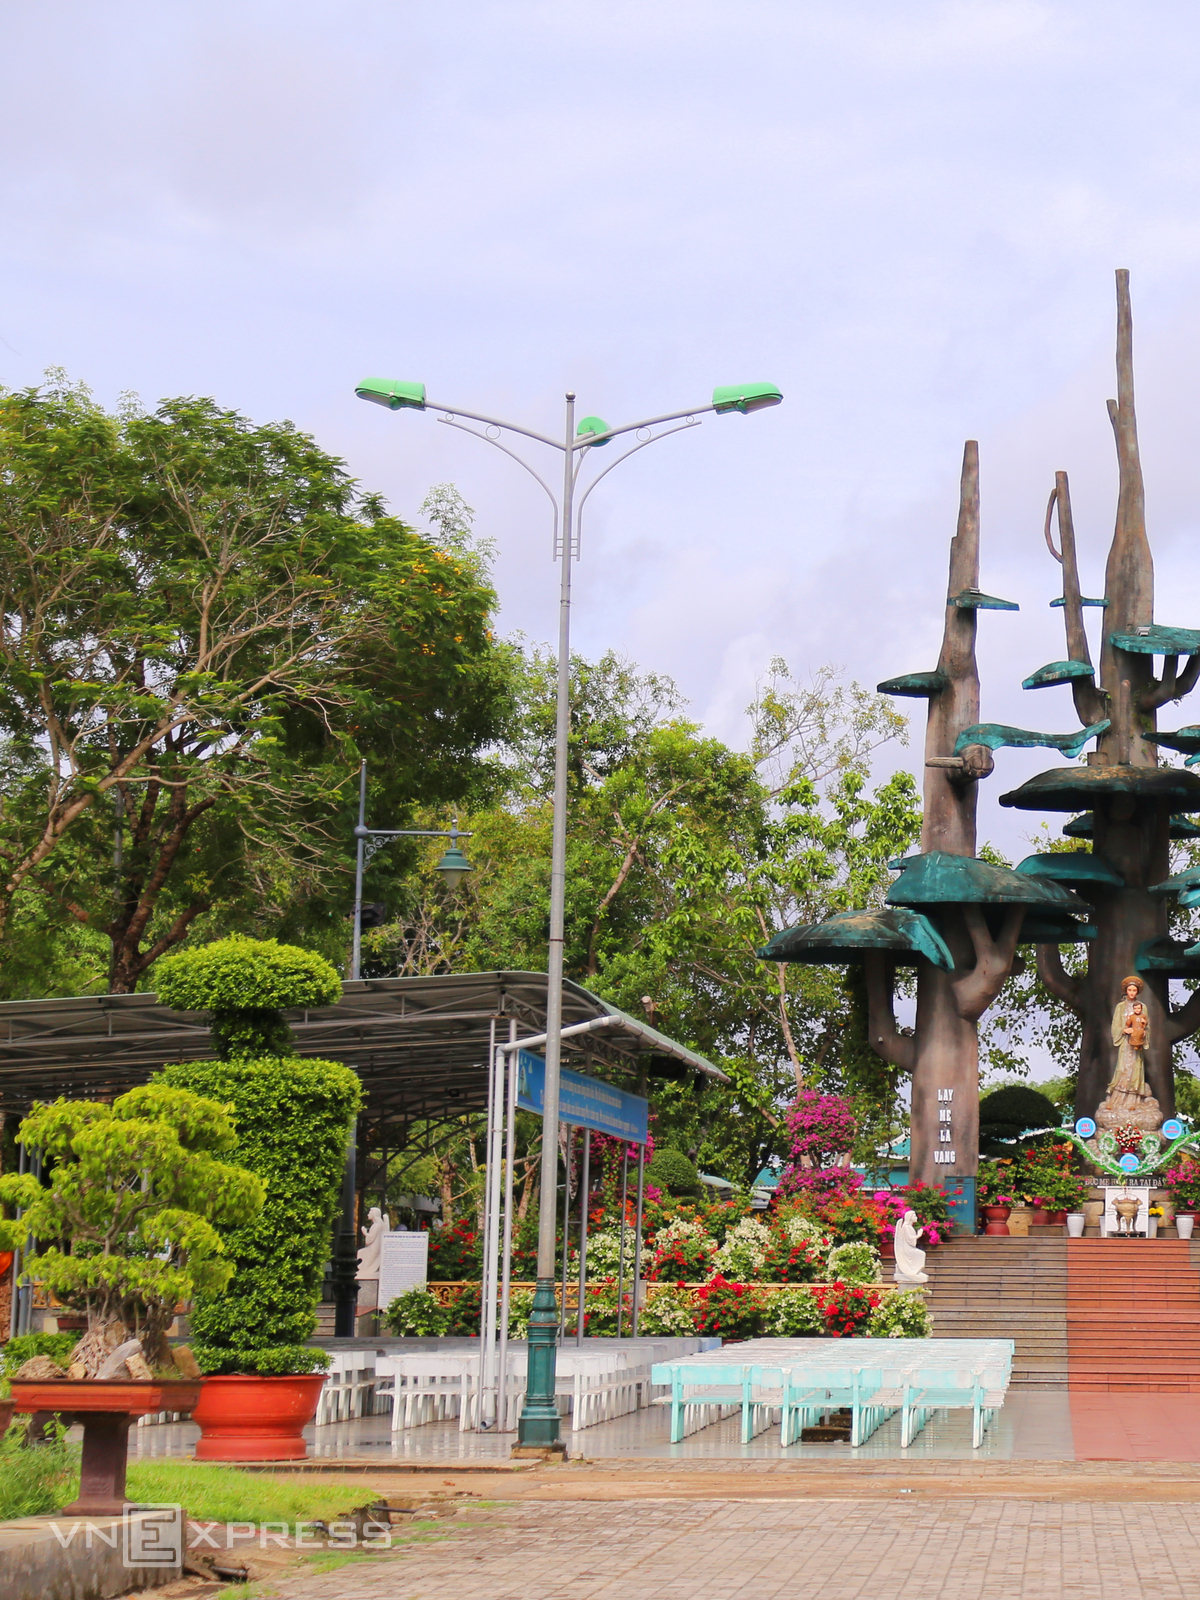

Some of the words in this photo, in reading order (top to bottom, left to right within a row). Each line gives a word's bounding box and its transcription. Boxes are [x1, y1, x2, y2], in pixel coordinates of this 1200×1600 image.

[940, 1129, 951, 1142] LA
[934, 1150, 956, 1163] VANG
[1129, 1178, 1139, 1186] RA
